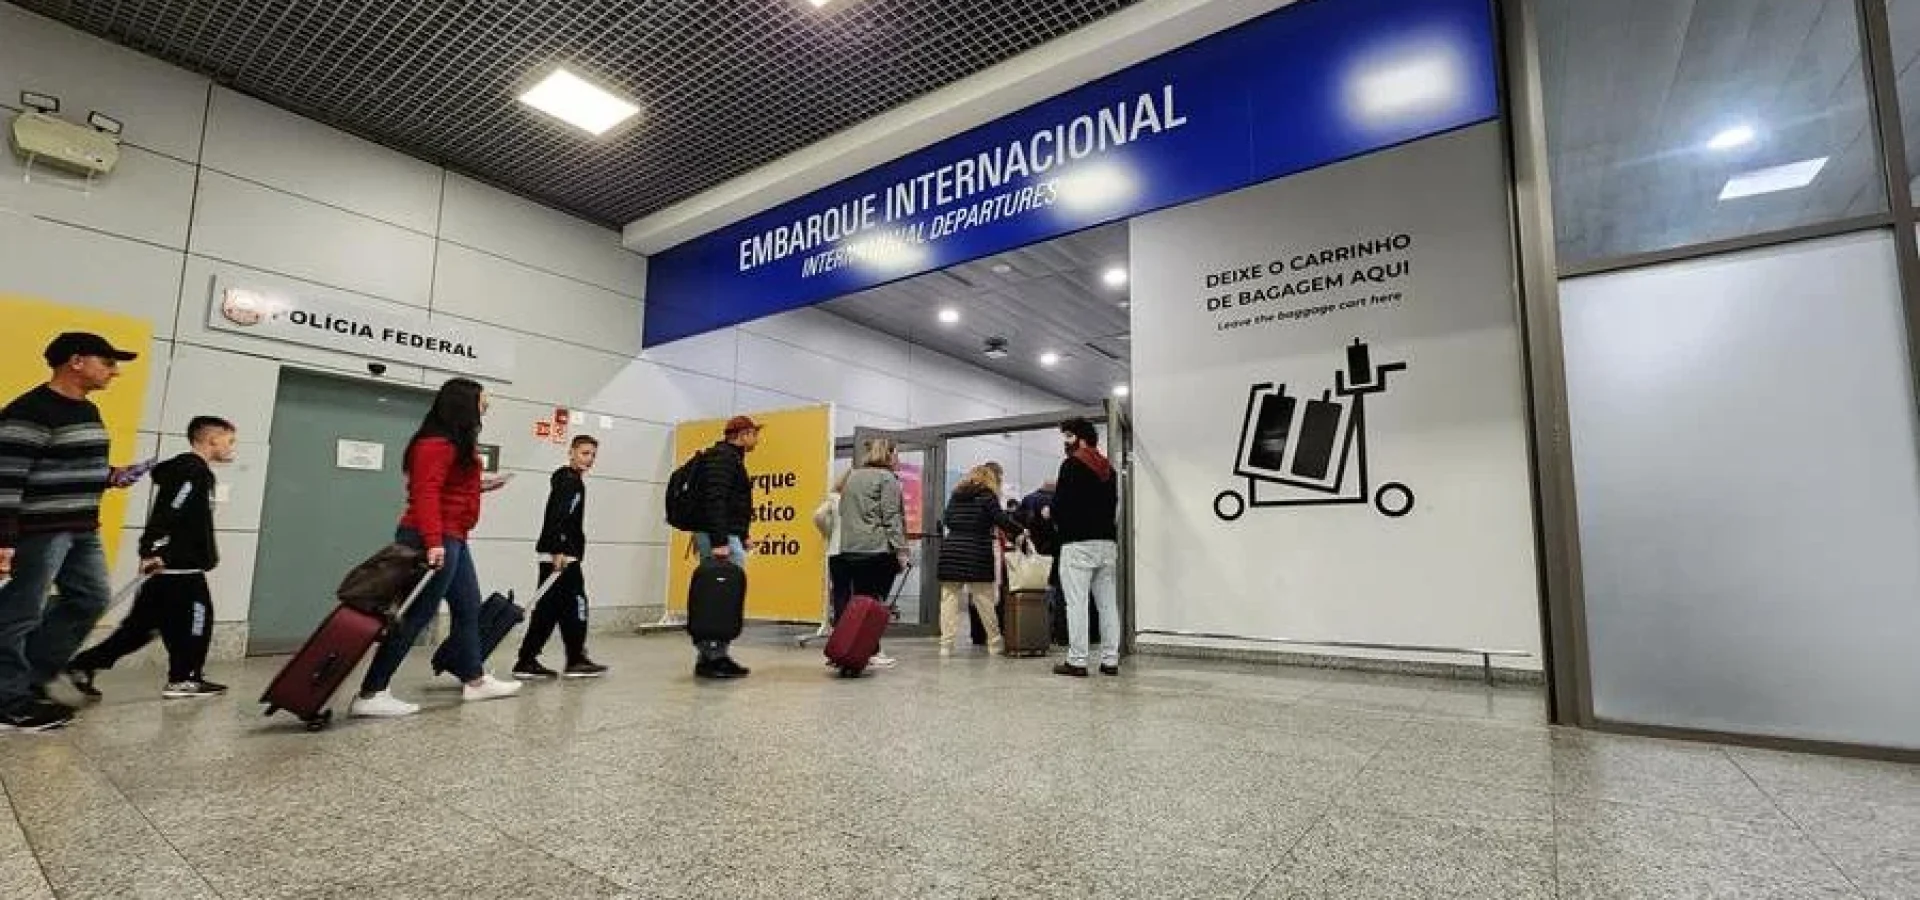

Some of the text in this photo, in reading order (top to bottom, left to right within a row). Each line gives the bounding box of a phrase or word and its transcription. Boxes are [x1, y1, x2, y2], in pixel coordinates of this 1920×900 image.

[739, 84, 1187, 272] EMBARQUE INTERNACIONAL
[930, 177, 1059, 241] DEPARTURES
[1206, 234, 1411, 288] DEIXE O CARRINHO
[1206, 260, 1409, 311] DE BAGAGEM AQUI
[272, 304, 478, 359] OLÍCIA FEDERAL
[1217, 291, 1402, 331] Leave the baggage cart here
